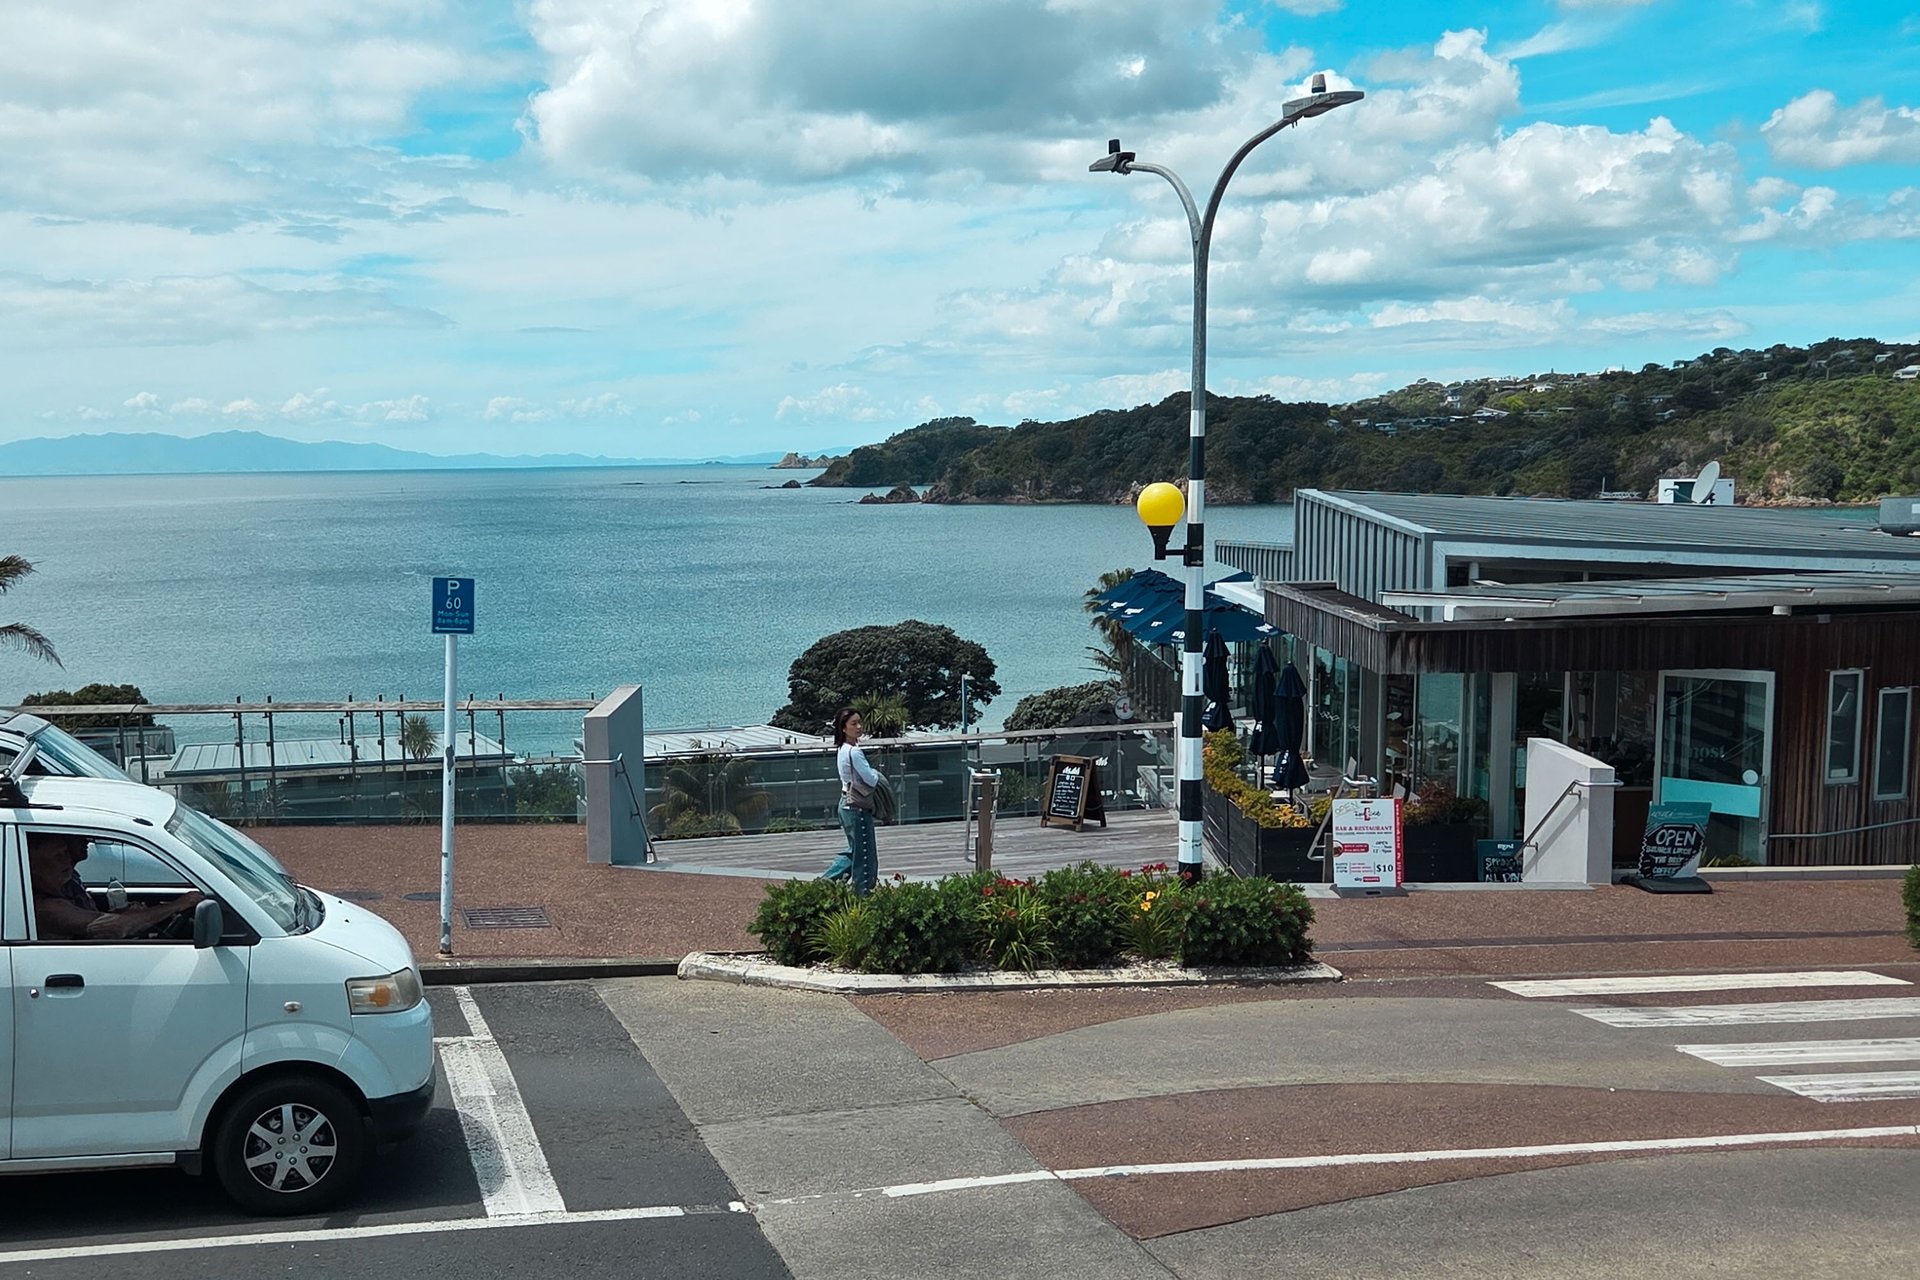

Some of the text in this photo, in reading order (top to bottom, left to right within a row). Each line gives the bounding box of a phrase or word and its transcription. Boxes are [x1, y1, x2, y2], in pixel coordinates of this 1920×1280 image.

[447, 580, 460, 595] P
[446, 596, 461, 609] 60
[1655, 829, 1697, 846] OPEN
[1376, 864, 1393, 872] $10
